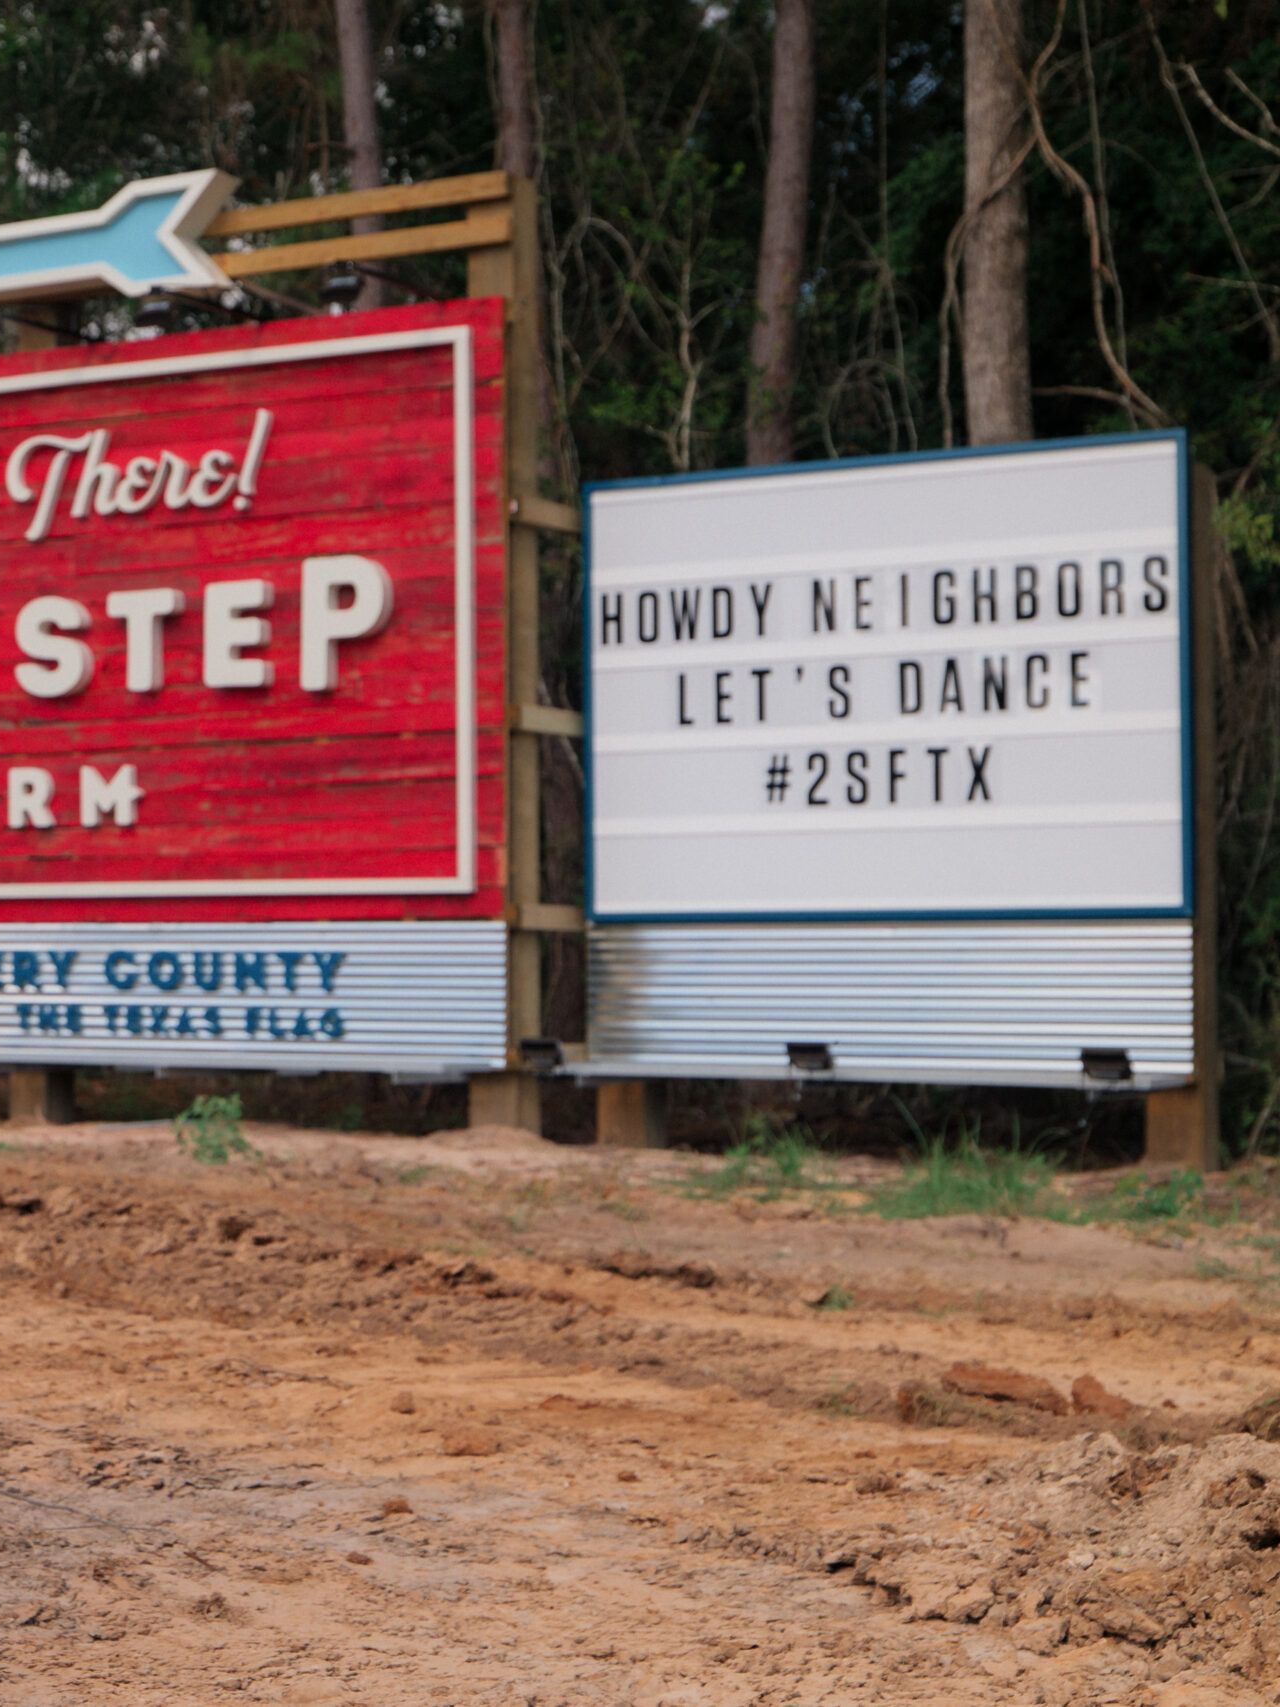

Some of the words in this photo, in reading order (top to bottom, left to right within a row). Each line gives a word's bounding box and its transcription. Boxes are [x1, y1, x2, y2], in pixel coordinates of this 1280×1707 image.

[5, 407, 274, 541] There!
[14, 554, 394, 697] STEP
[601, 582, 772, 645] HOWDY
[812, 555, 1171, 632] NEIGHBORS
[678, 664, 851, 726] LET'S
[899, 651, 1091, 714] DANCE
[765, 745, 993, 805] #2SFTX
[105, 951, 346, 993] COUNTY
[17, 1003, 81, 1034] THE
[104, 1004, 223, 1036] TEXAS
[245, 1006, 344, 1038] FLAG
